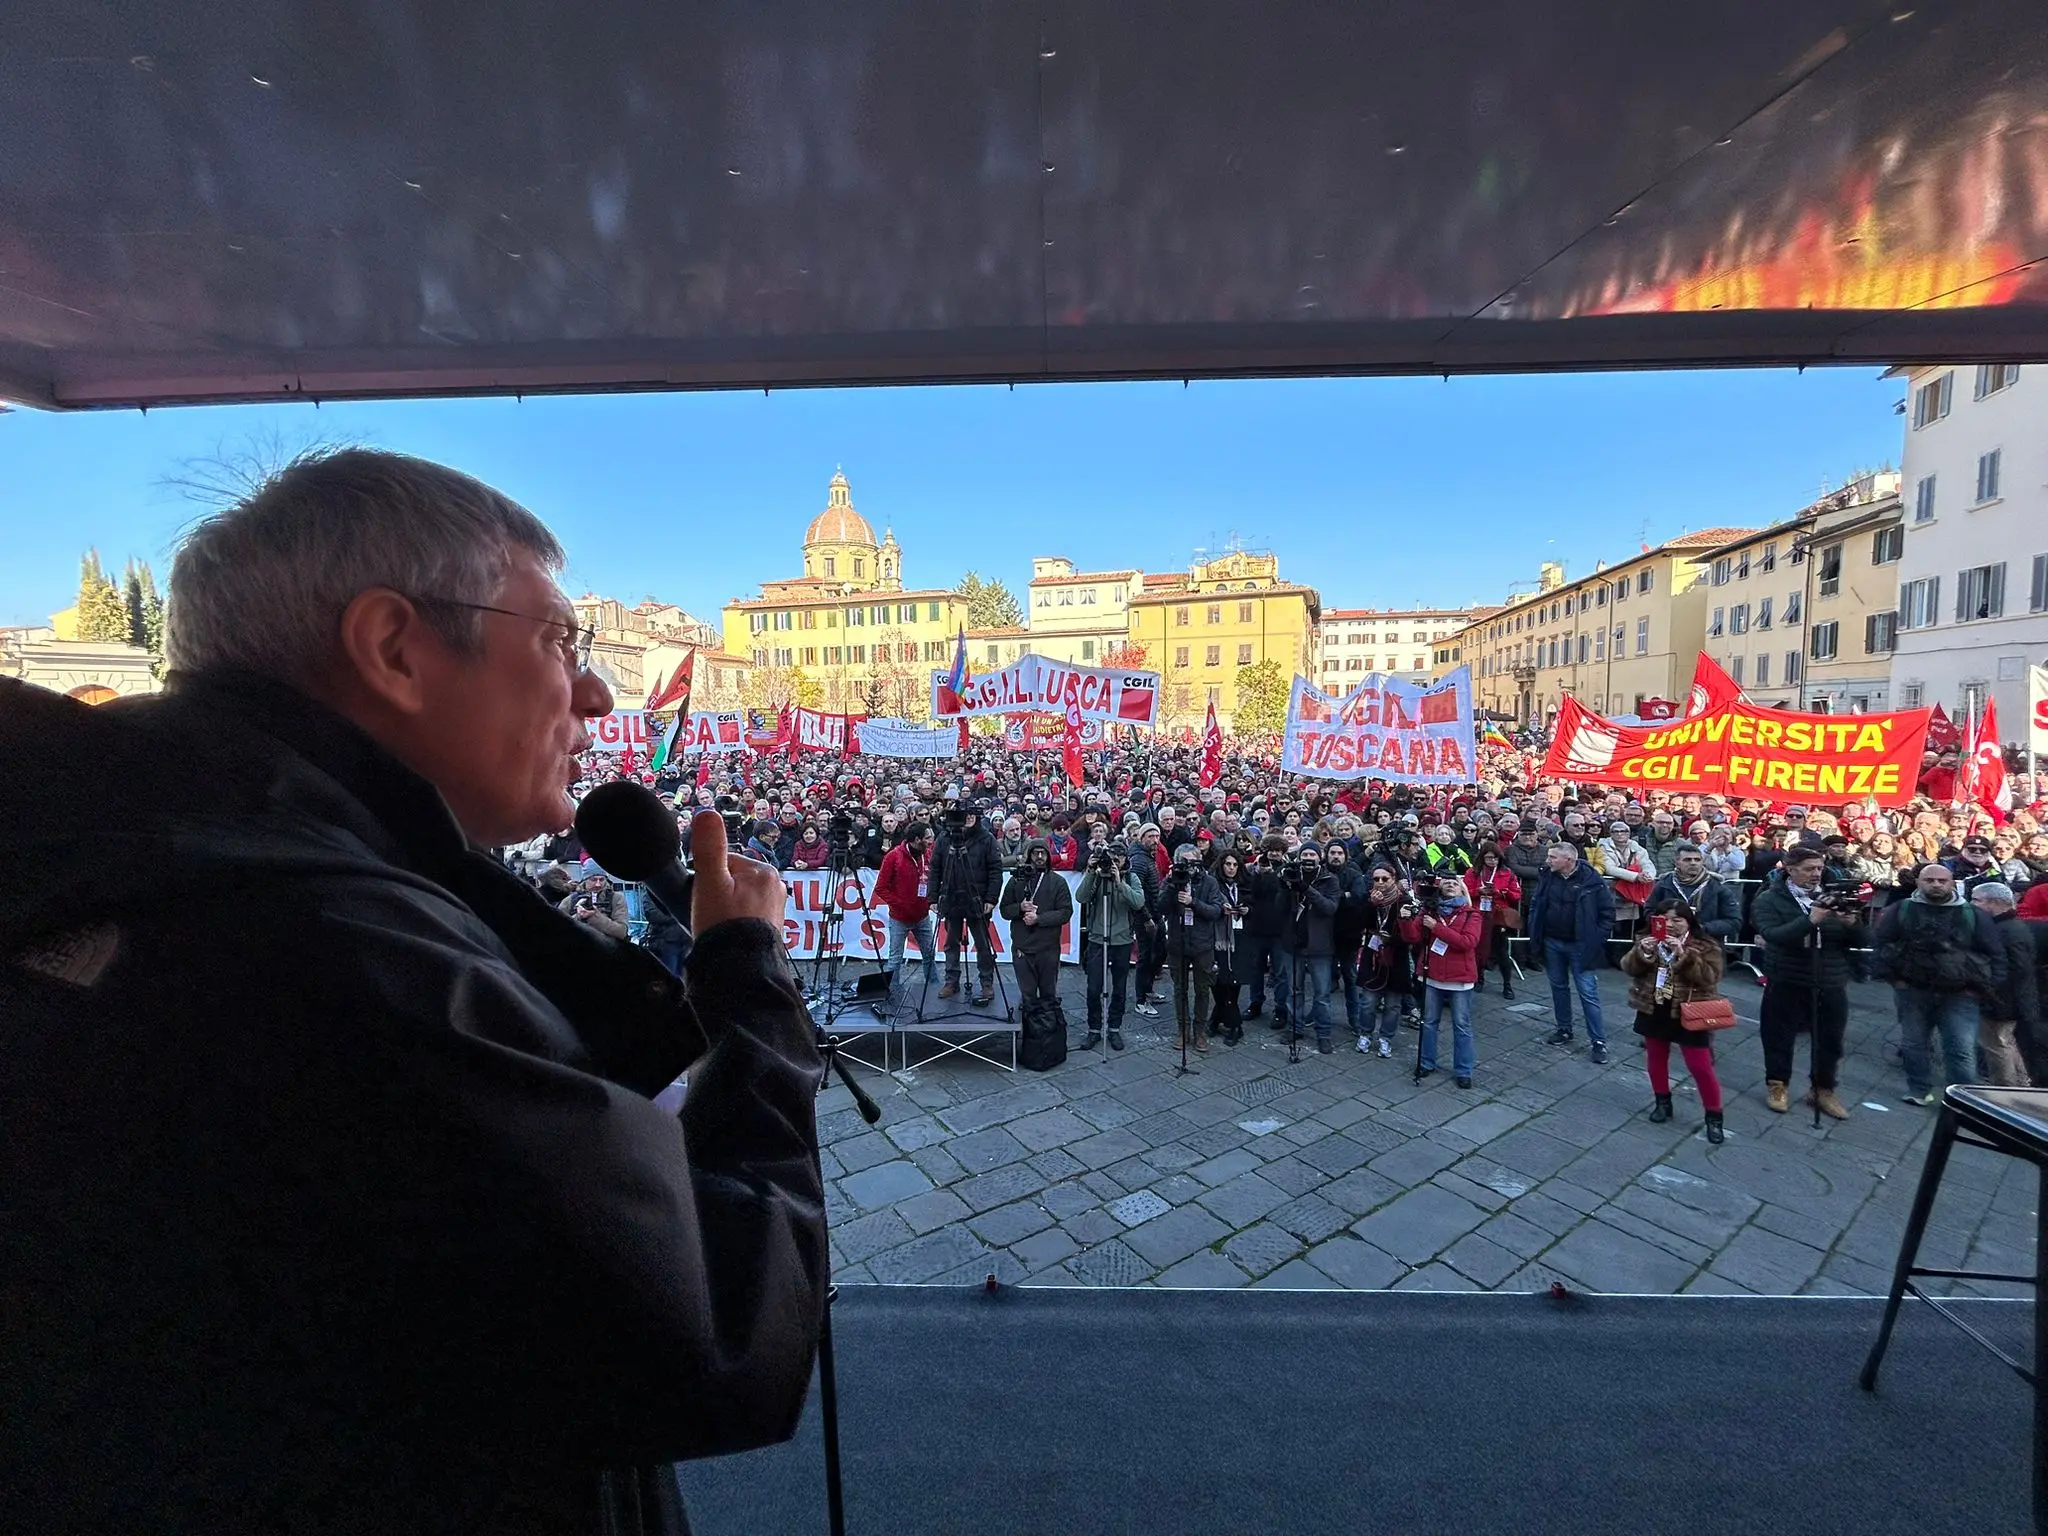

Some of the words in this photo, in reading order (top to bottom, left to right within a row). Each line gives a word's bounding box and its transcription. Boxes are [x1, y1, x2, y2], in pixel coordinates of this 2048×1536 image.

[1122, 677, 1155, 688] CGIL
[717, 714, 738, 722] CGIL
[1296, 731, 1467, 776] TOSCANA
